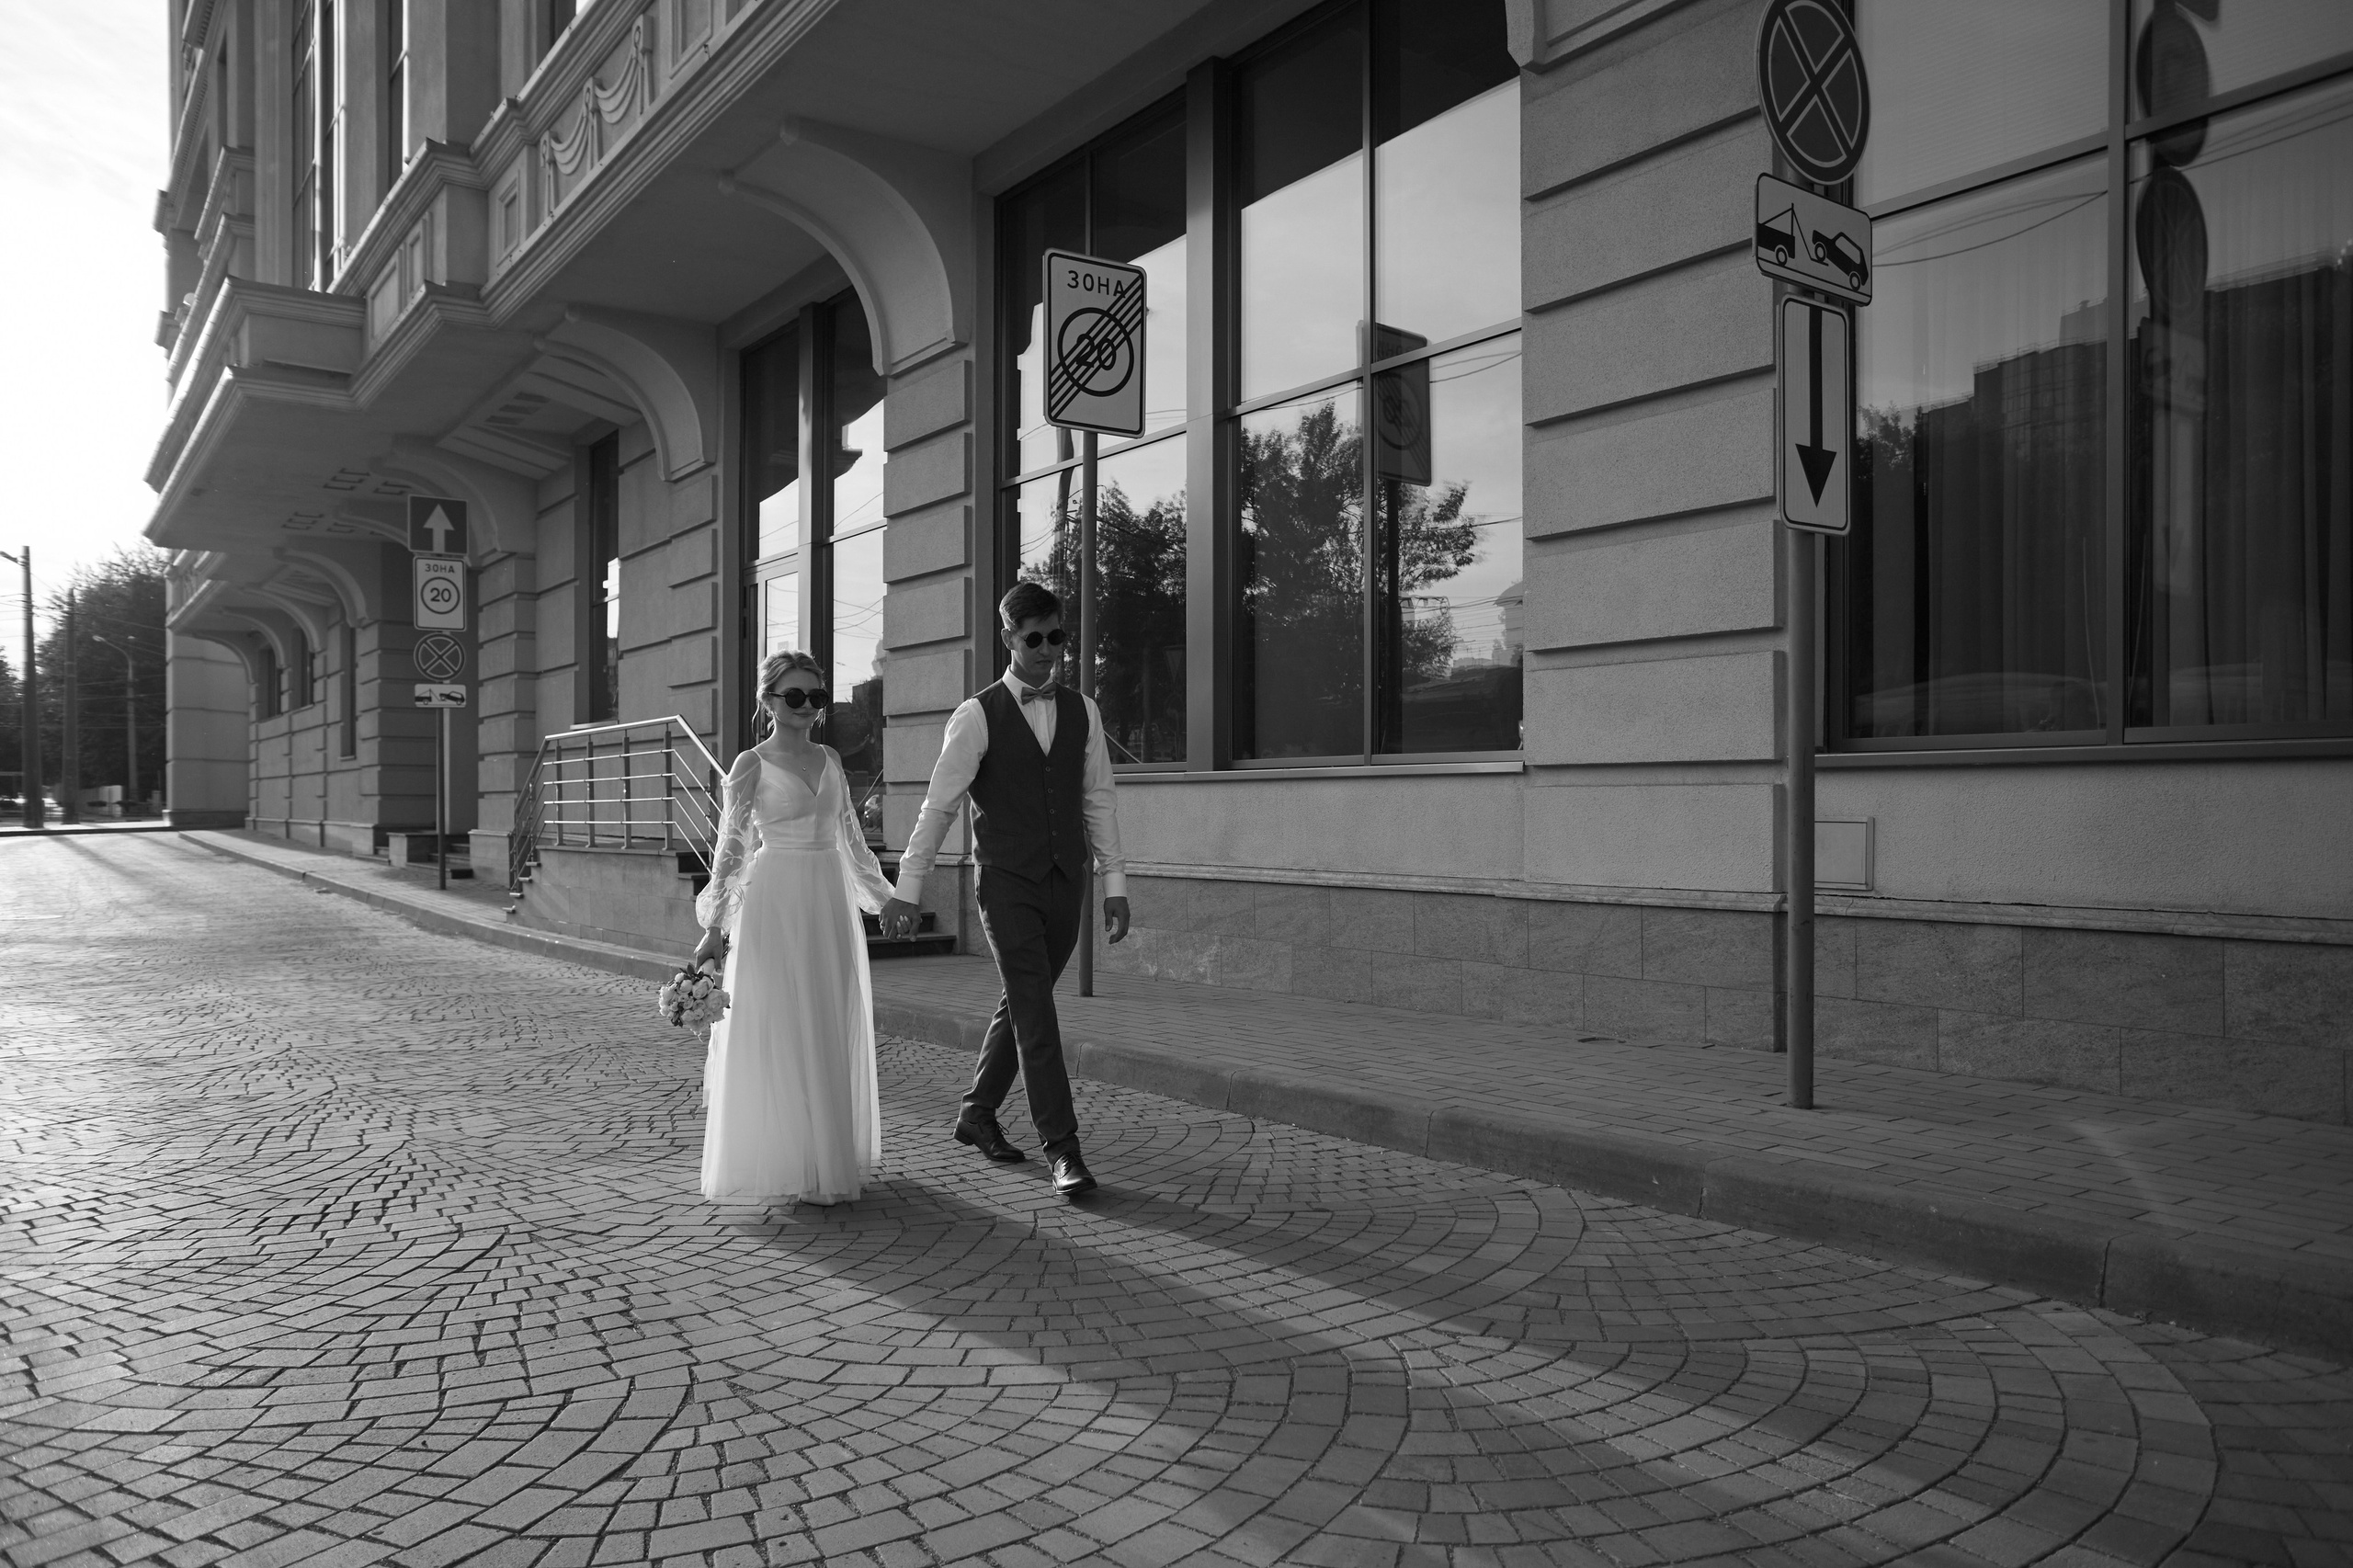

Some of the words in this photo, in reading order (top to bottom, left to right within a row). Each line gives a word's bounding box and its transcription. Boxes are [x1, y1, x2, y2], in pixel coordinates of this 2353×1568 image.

[1067, 269, 1126, 299] ЗОНА
[1075, 333, 1117, 371] 20
[425, 563, 455, 574] ЗОНА
[429, 587, 452, 603] 20
